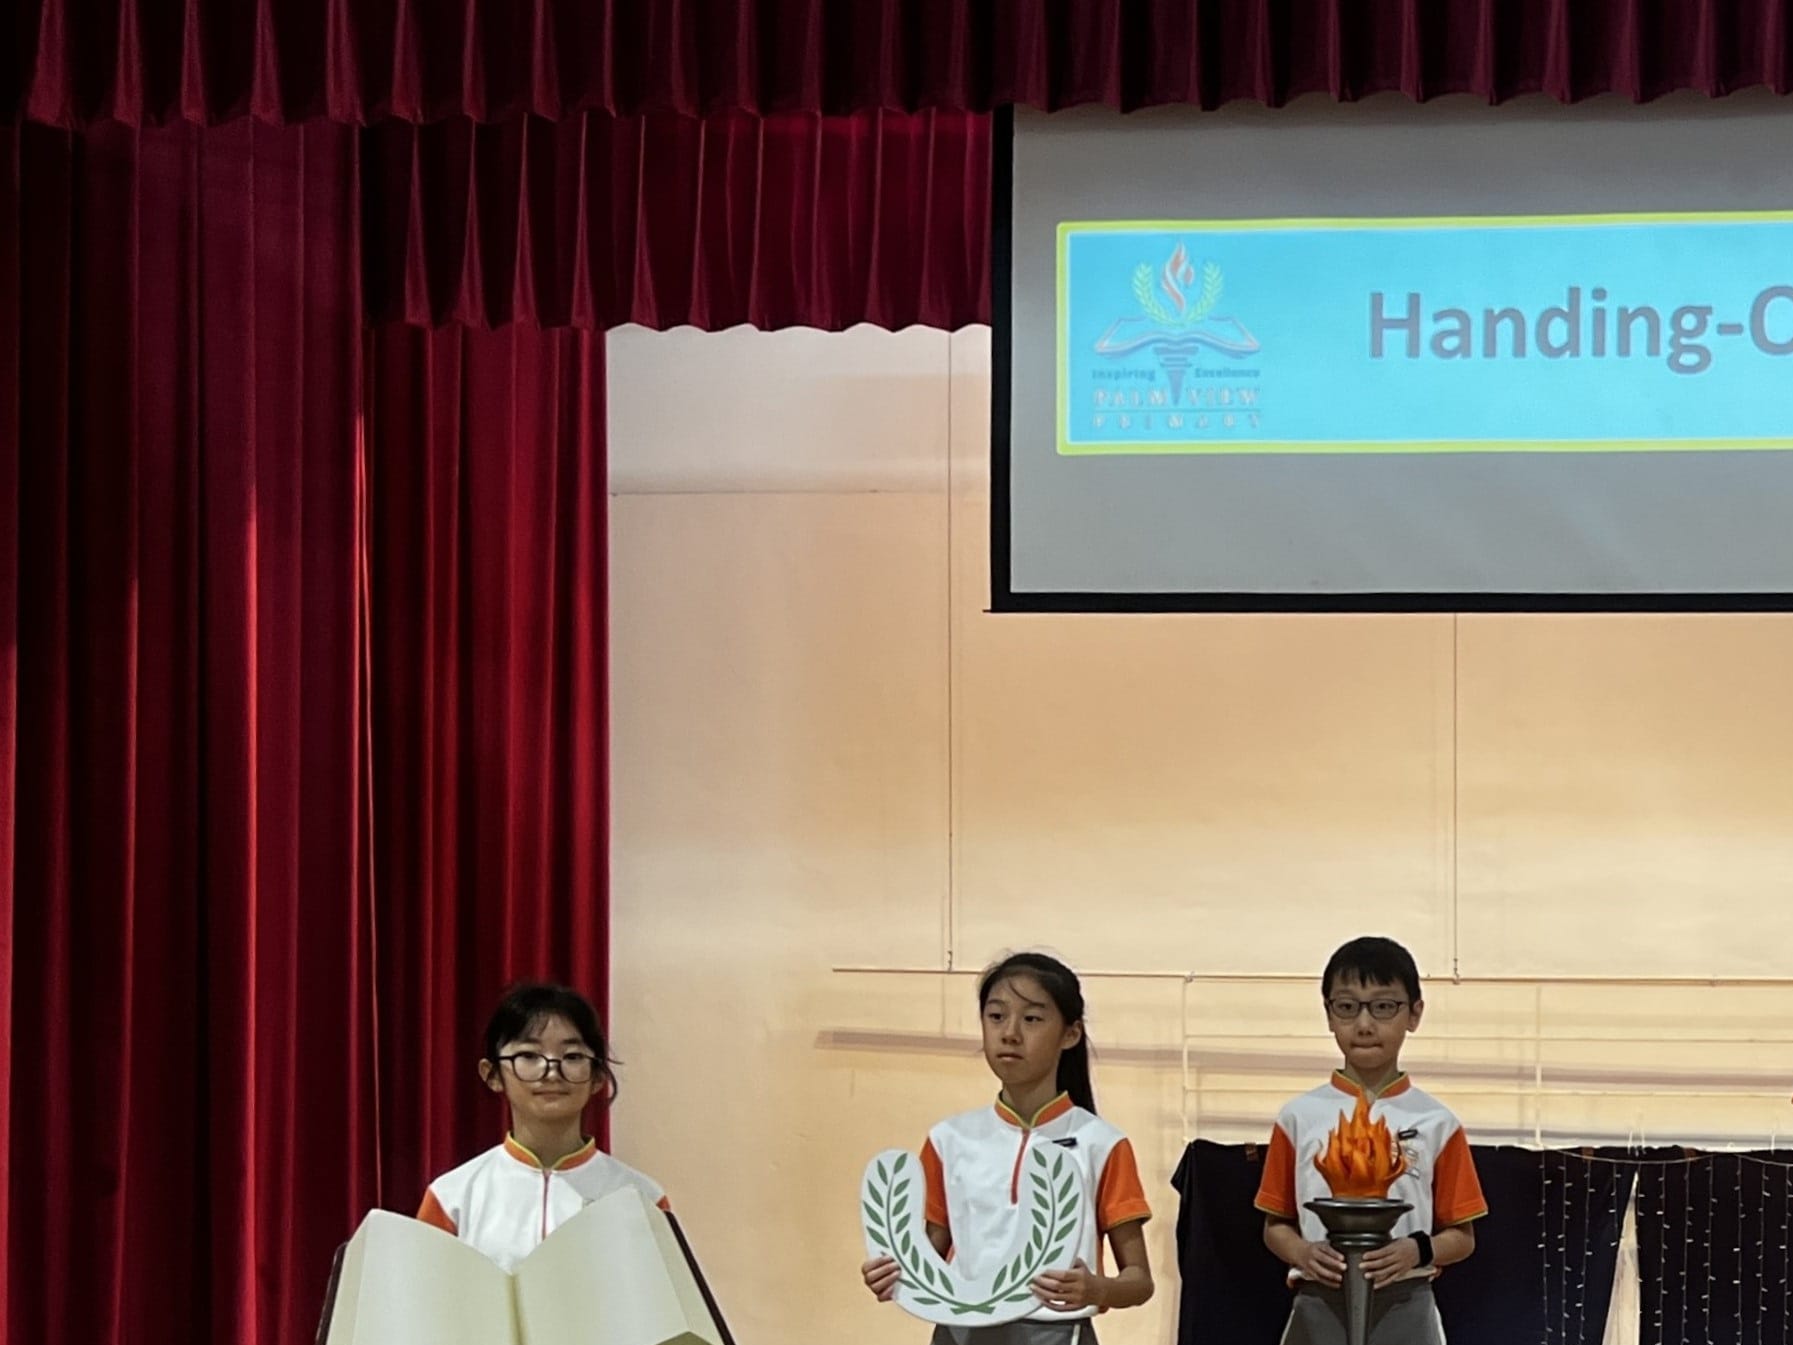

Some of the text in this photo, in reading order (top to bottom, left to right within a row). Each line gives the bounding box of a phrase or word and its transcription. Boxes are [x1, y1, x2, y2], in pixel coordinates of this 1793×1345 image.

[1092, 367, 1260, 381] Inspiring Excellence
[1094, 386, 1261, 406] PALM VIEW
